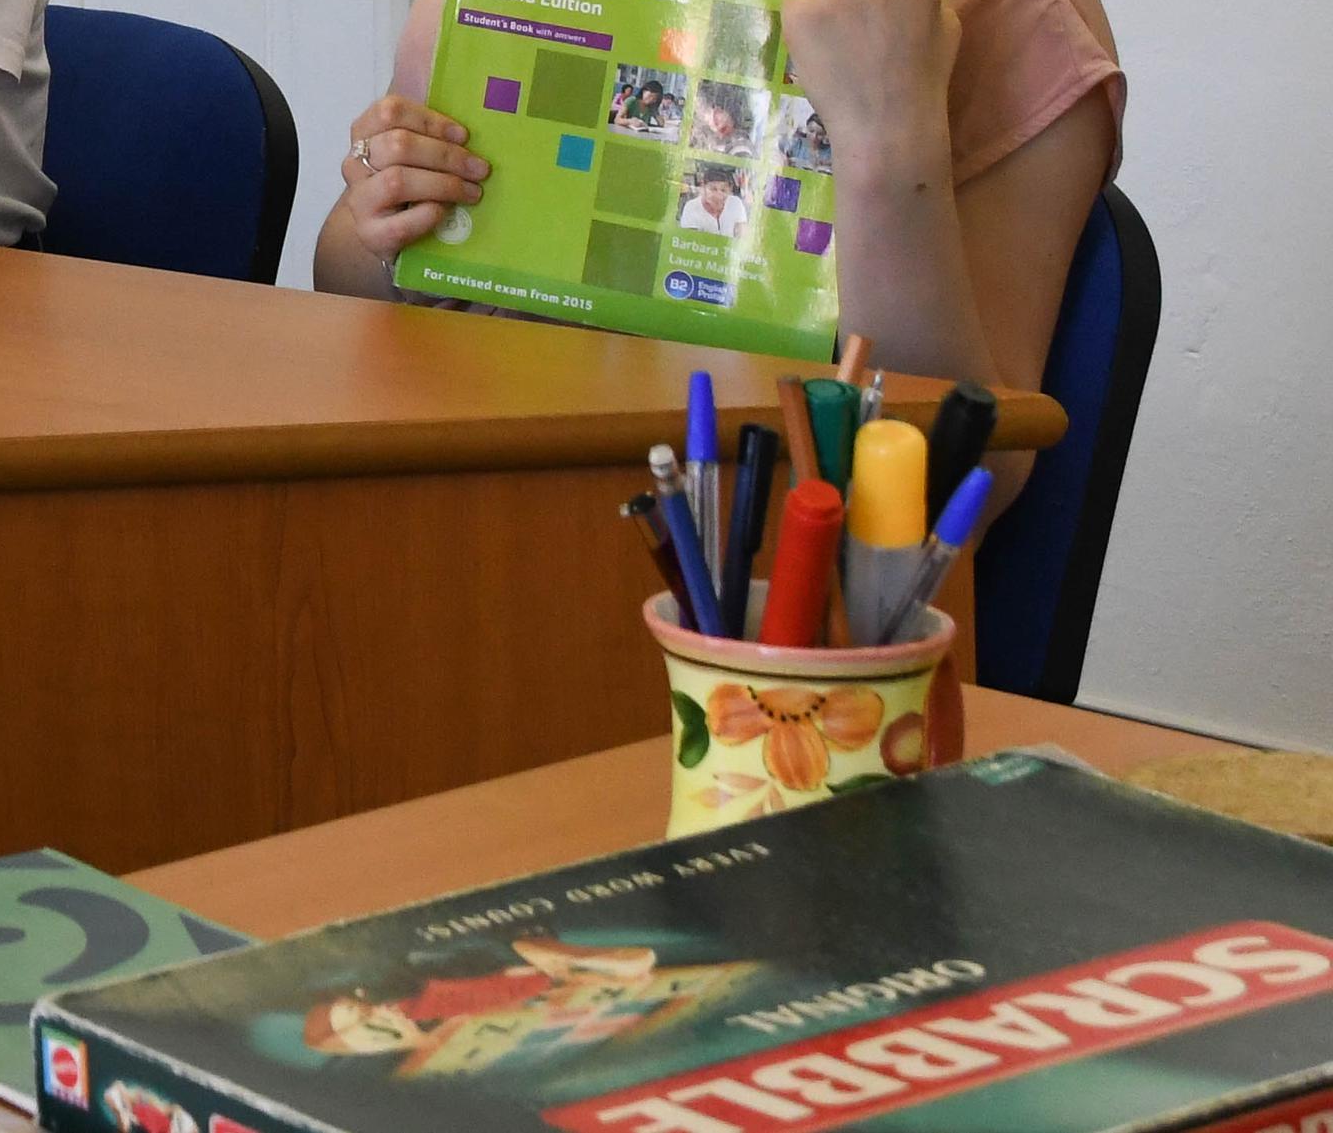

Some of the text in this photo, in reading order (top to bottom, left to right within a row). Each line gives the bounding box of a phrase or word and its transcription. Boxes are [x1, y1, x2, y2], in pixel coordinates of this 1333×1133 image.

[464, 12, 586, 43] Student's Book with answers
[669, 253, 702, 269] Laura
[671, 236, 719, 256] Barbara
[423, 268, 593, 311] For revised exam from 2015
[670, 278, 688, 292] B2
[565, 870, 665, 904] WORD
[726, 958, 989, 1036] ORIGINAL
[596, 933, 1331, 1133] SCRABBLE
